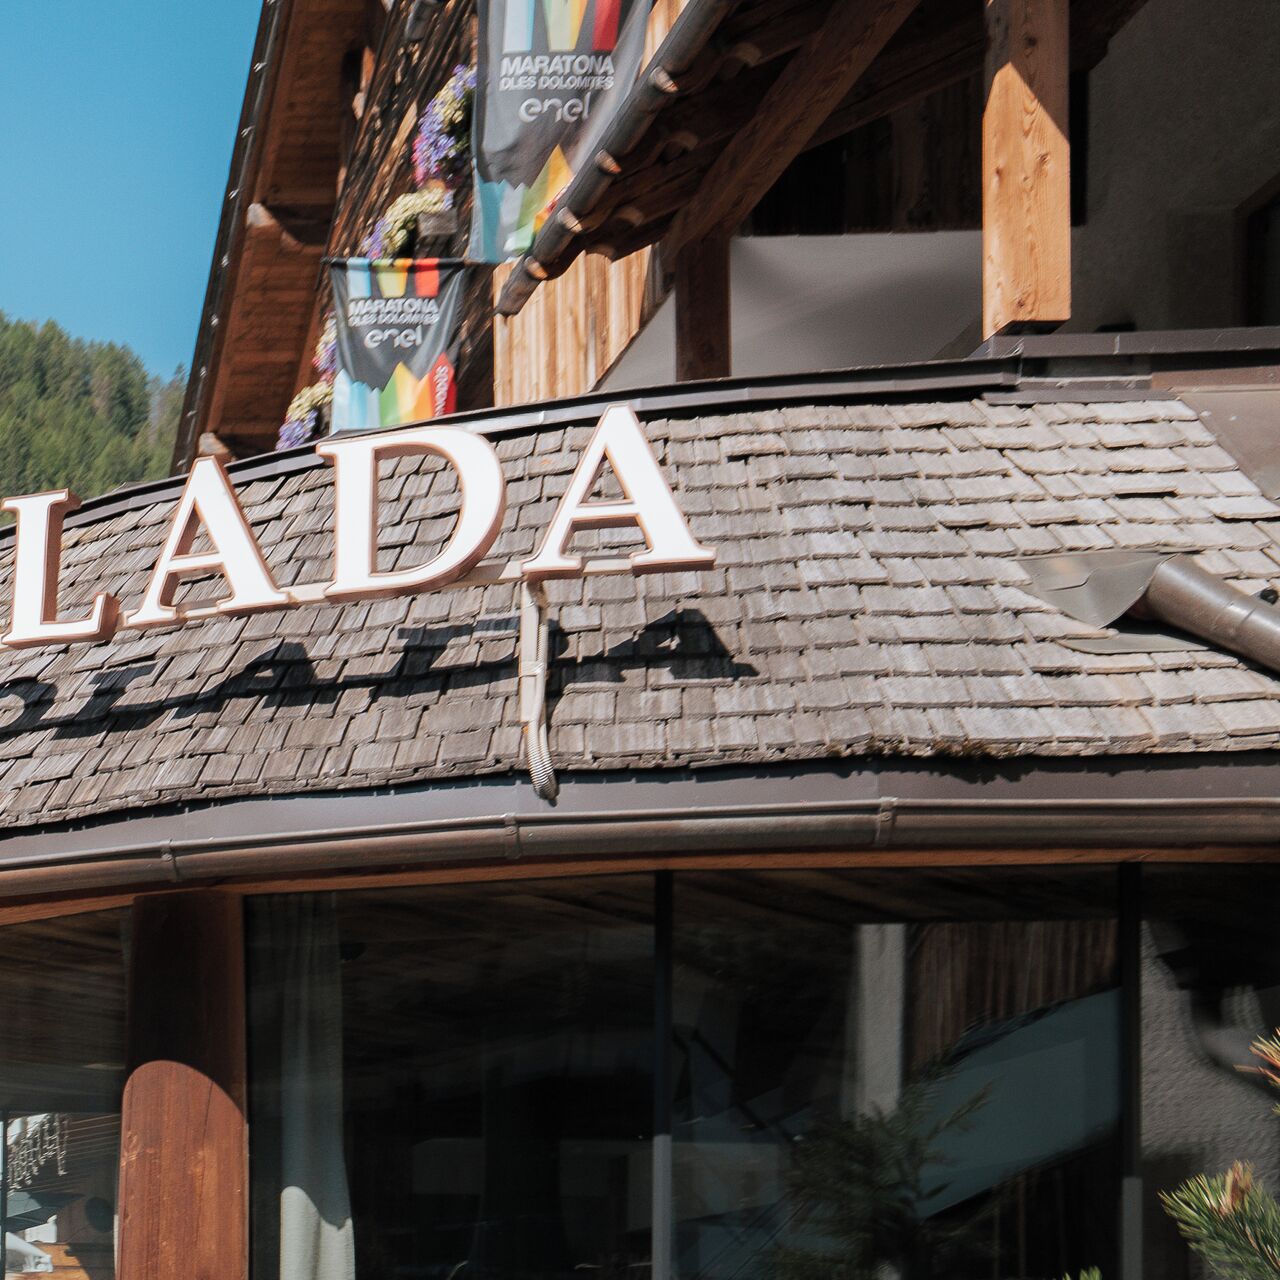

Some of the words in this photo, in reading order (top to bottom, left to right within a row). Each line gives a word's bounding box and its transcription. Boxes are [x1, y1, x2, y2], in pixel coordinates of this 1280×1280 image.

[500, 55, 615, 76] MARATONA
[500, 76, 536, 91] DLES
[538, 75, 615, 91] DOLOMITES
[519, 92, 592, 123] enel
[348, 298, 439, 316] MARATONA
[364, 325, 423, 349] enel
